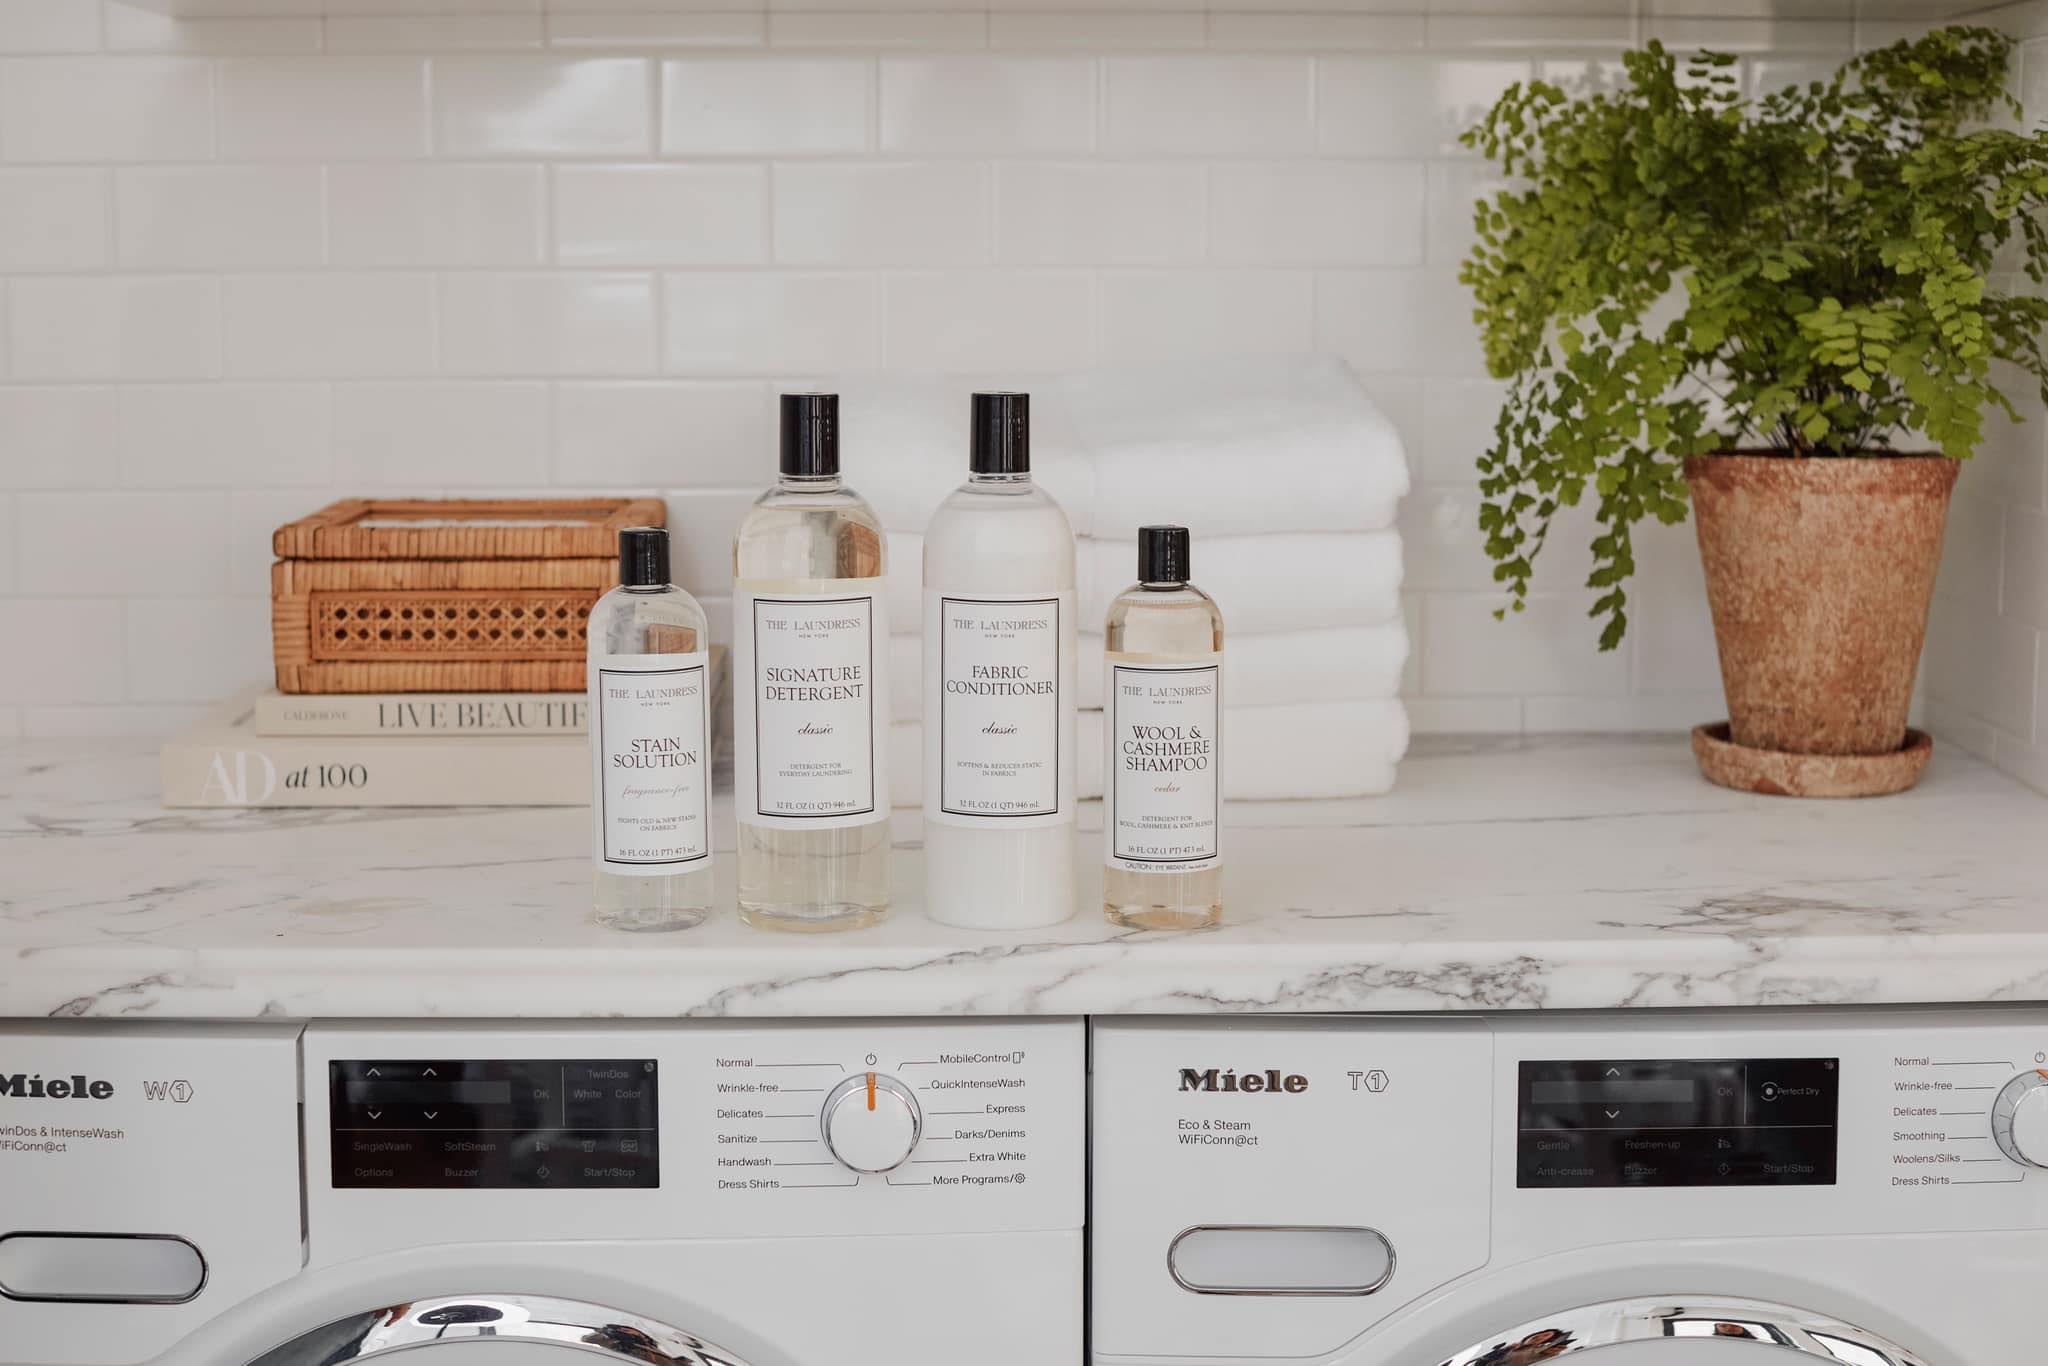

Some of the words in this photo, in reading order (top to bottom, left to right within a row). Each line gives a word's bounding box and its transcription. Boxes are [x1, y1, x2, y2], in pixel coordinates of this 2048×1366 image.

[766, 619, 788, 630] THE
[794, 618, 860, 630] LAUNDRESS
[954, 619, 974, 630] THE
[981, 619, 1047, 630] LAUNDRESS
[767, 666, 861, 682] SIGNATURE
[972, 666, 1028, 679] FABRIC
[608, 688, 630, 699] THE
[636, 686, 697, 699] LAUNDRESS
[766, 684, 863, 701] DETERGENT
[947, 680, 1054, 696] CONDITIONER
[1122, 686, 1142, 696] THE
[1149, 685, 1211, 697] LAUNDRESS
[378, 703, 447, 729] LIVE
[798, 722, 834, 735] classic
[982, 722, 1018, 734] classic
[1133, 725, 1185, 739] WOOL
[1190, 725, 1202, 739] &
[631, 737, 680, 753] STAIN
[1124, 740, 1210, 755] CASHMERE
[613, 751, 696, 768] SOLUTION
[1126, 757, 1208, 772] SHAMPOO
[200, 750, 276, 803] AD
[285, 766, 309, 788] at
[318, 764, 367, 788] 100
[1154, 782, 1181, 793] cedar
[785, 802, 795, 810] FL
[796, 802, 807, 810] OZ
[818, 802, 832, 810] QT)
[833, 801, 846, 809] 946
[847, 800, 856, 808] mL
[968, 800, 977, 808] FL
[979, 801, 990, 809] OZ
[1000, 801, 1014, 809] QT)
[1015, 800, 1028, 808] 946
[1030, 799, 1039, 807] mL
[688, 845, 696, 853] mL
[1196, 844, 1204, 852] mL
[716, 1059, 753, 1067] Normal
[940, 1053, 1011, 1064] MobileControl
[1894, 1057, 1929, 1065] Normal
[589, 1070, 629, 1079] TwinDos
[931, 1078, 1026, 1090] QuickIntenseWash
[1178, 1068, 1308, 1093] Miele
[0, 1074, 114, 1099] Miele
[717, 1083, 779, 1093] Wrinkle-free
[1895, 1082, 1952, 1090] Wrinkle-free
[534, 1090, 549, 1098] OK
[574, 1089, 602, 1099] White
[615, 1089, 641, 1099] Color
[1719, 1087, 1733, 1096] OK
[1777, 1087, 1803, 1095] Perfect
[1806, 1087, 1820, 1097] Dry
[717, 1109, 763, 1118] Delicates
[986, 1104, 1026, 1115] Express
[1894, 1107, 1937, 1116] Delicates
[1179, 1120, 1200, 1130] Eco
[1203, 1120, 1211, 1130] &
[1214, 1120, 1251, 1130] Steam
[40, 1127, 47, 1136] &
[52, 1128, 124, 1139] IntenseWash
[955, 1129, 1026, 1139] Darks/Denims
[1893, 1131, 1945, 1141] Smoothing
[718, 1134, 758, 1144] Sanitize
[1179, 1134, 1258, 1146] WiFiConn@ct
[0, 1140, 66, 1153] iFiConn@ct
[354, 1142, 412, 1153] SingleWash
[445, 1141, 496, 1152] SoftSteam
[1537, 1141, 1569, 1151] Gentle
[1625, 1140, 1680, 1151] Freshen-up
[969, 1152, 995, 1162] Extra
[997, 1151, 1026, 1161] White
[1893, 1154, 1960, 1163] Woolens/Silks
[718, 1157, 772, 1167] Handwash
[354, 1168, 393, 1178] Options
[445, 1168, 479, 1177] Buzzer
[583, 1167, 635, 1178] Start/Stop
[1537, 1167, 1594, 1176] Anti-crease
[1624, 1166, 1657, 1175] Buzzer
[1763, 1164, 1814, 1174] Start/Stop
[718, 1179, 748, 1189] Dress
[750, 1179, 780, 1189] Shirts
[933, 1175, 959, 1185] More
[1892, 1177, 1919, 1186] Dress
[1921, 1176, 1949, 1185] Shirts
